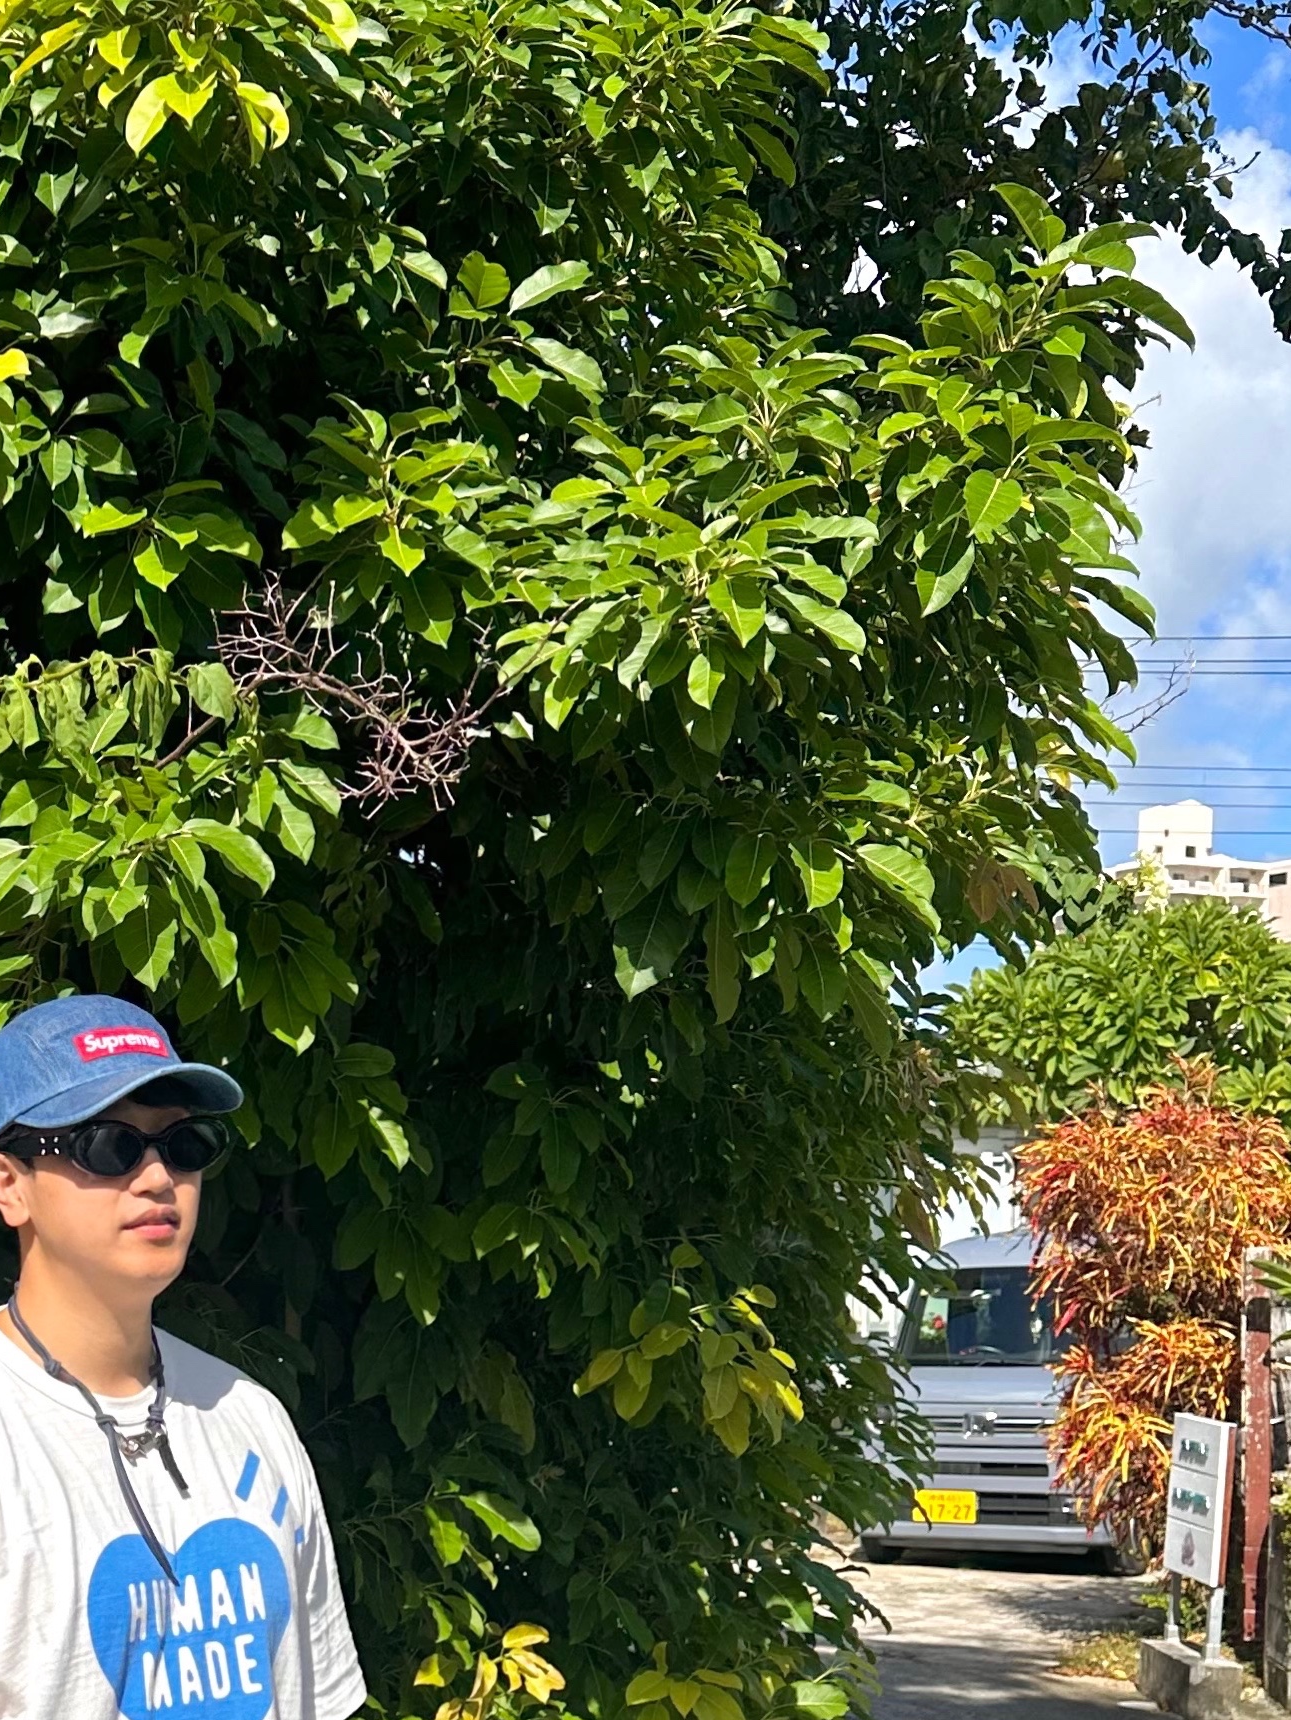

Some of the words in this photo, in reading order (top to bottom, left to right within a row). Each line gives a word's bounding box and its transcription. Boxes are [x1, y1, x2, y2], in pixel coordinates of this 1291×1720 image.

[83, 1032, 161, 1054] Supreme
[128, 1562, 267, 1643] HUMAN
[142, 1633, 263, 1711] MADE
